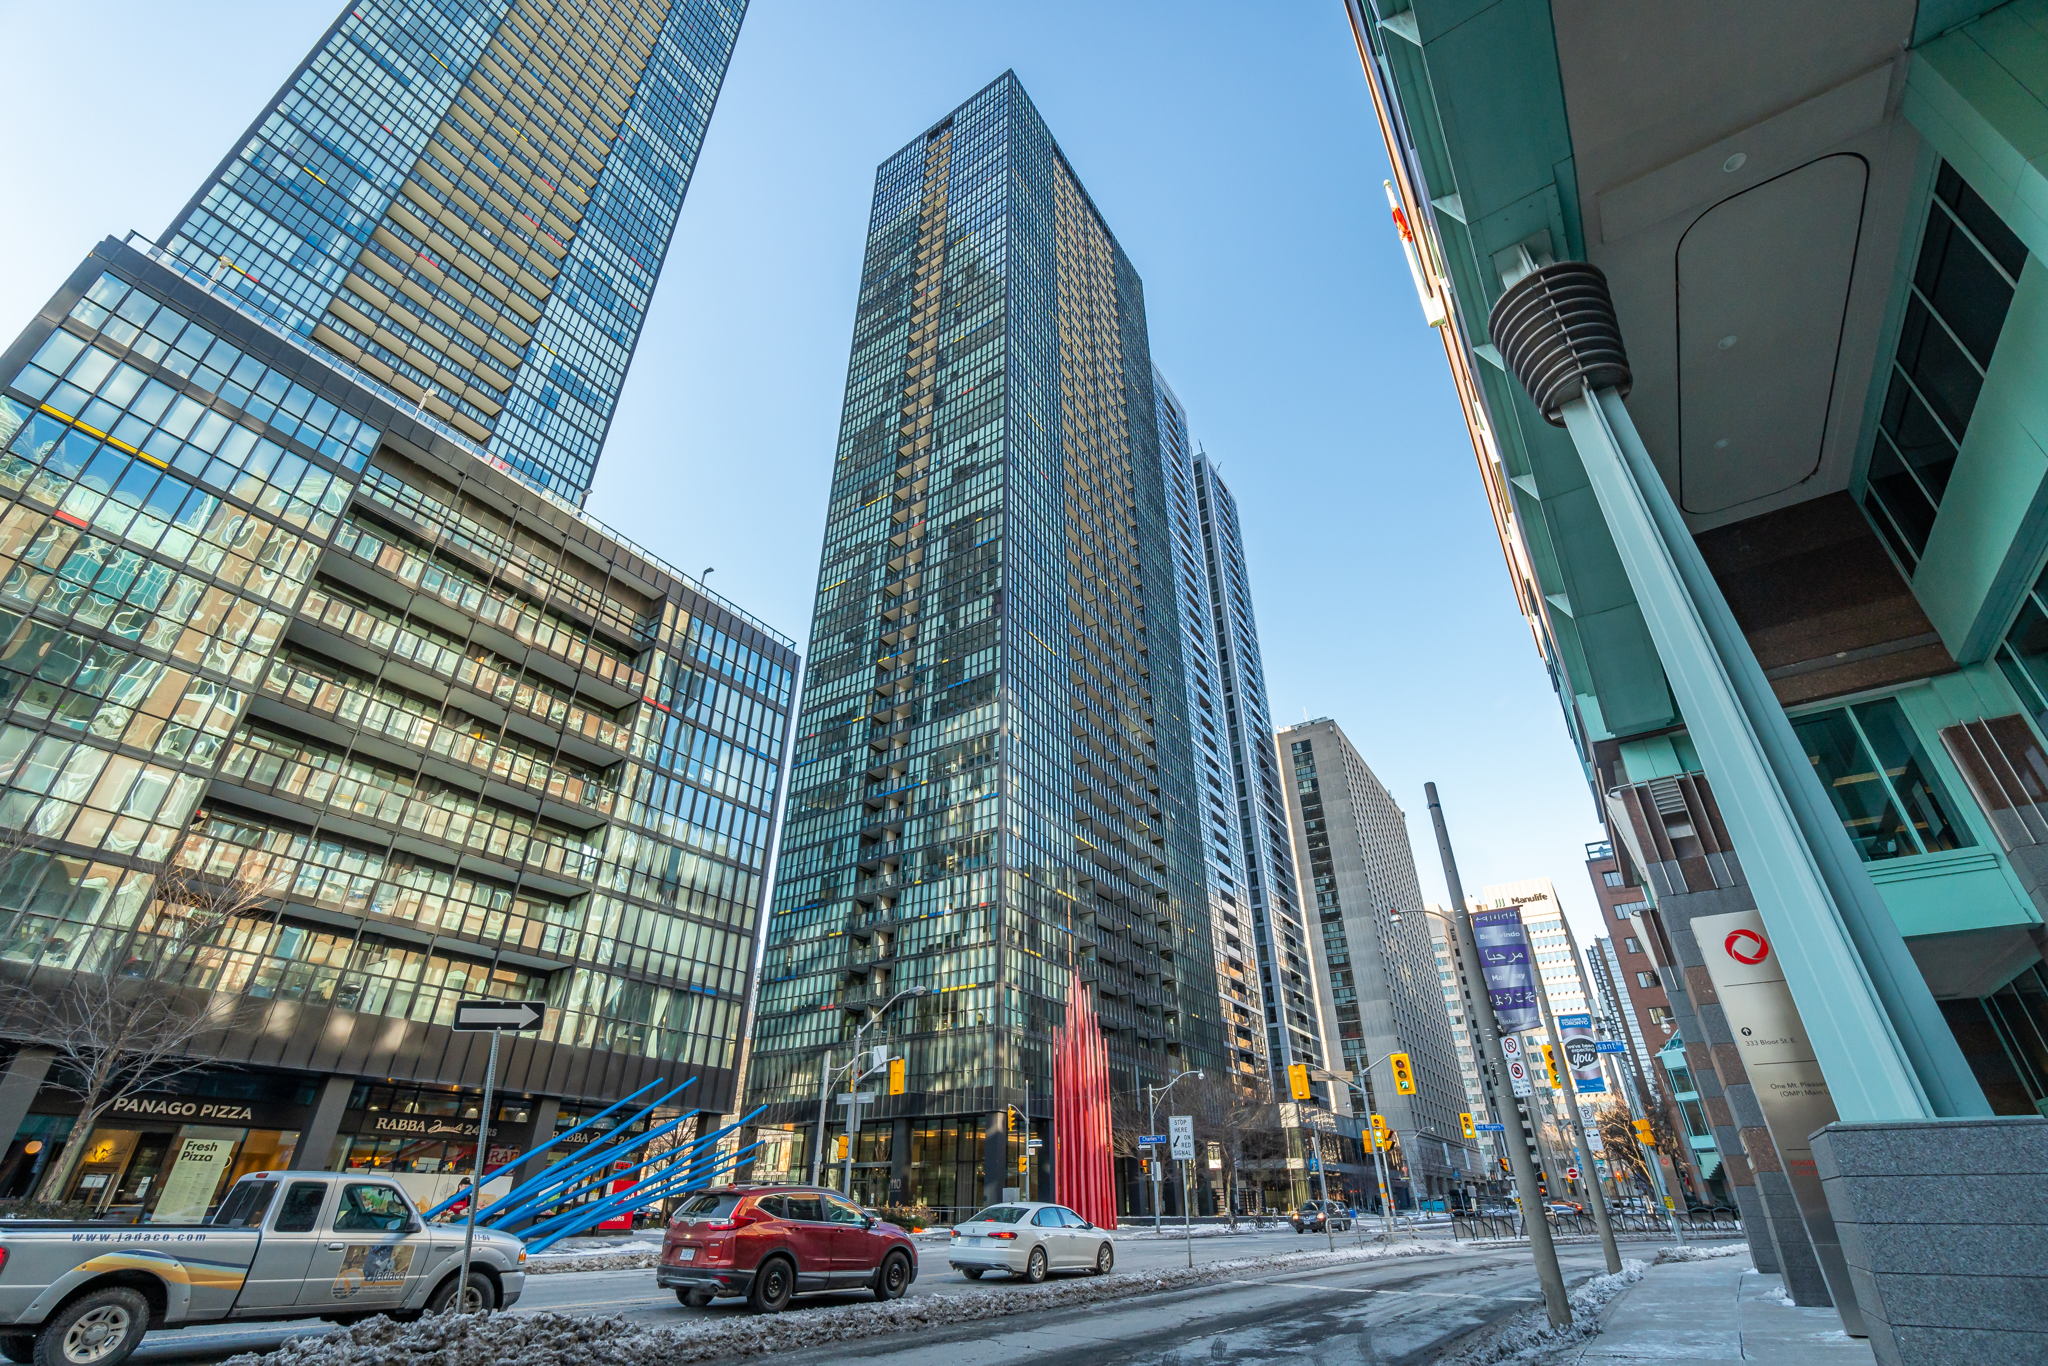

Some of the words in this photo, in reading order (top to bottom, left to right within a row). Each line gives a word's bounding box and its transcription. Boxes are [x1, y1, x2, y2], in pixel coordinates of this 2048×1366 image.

[1510, 893, 1548, 905] Manulife
[1495, 991, 1535, 1006] ようこそ
[1573, 1052, 1594, 1068] you
[112, 1098, 196, 1116] PANAGO
[200, 1104, 252, 1119] PIZZA
[375, 1117, 426, 1133] RABBA
[185, 1140, 218, 1152] Fresh
[180, 1151, 213, 1162] Pizza
[71, 1231, 207, 1243] www.jadaco.com
